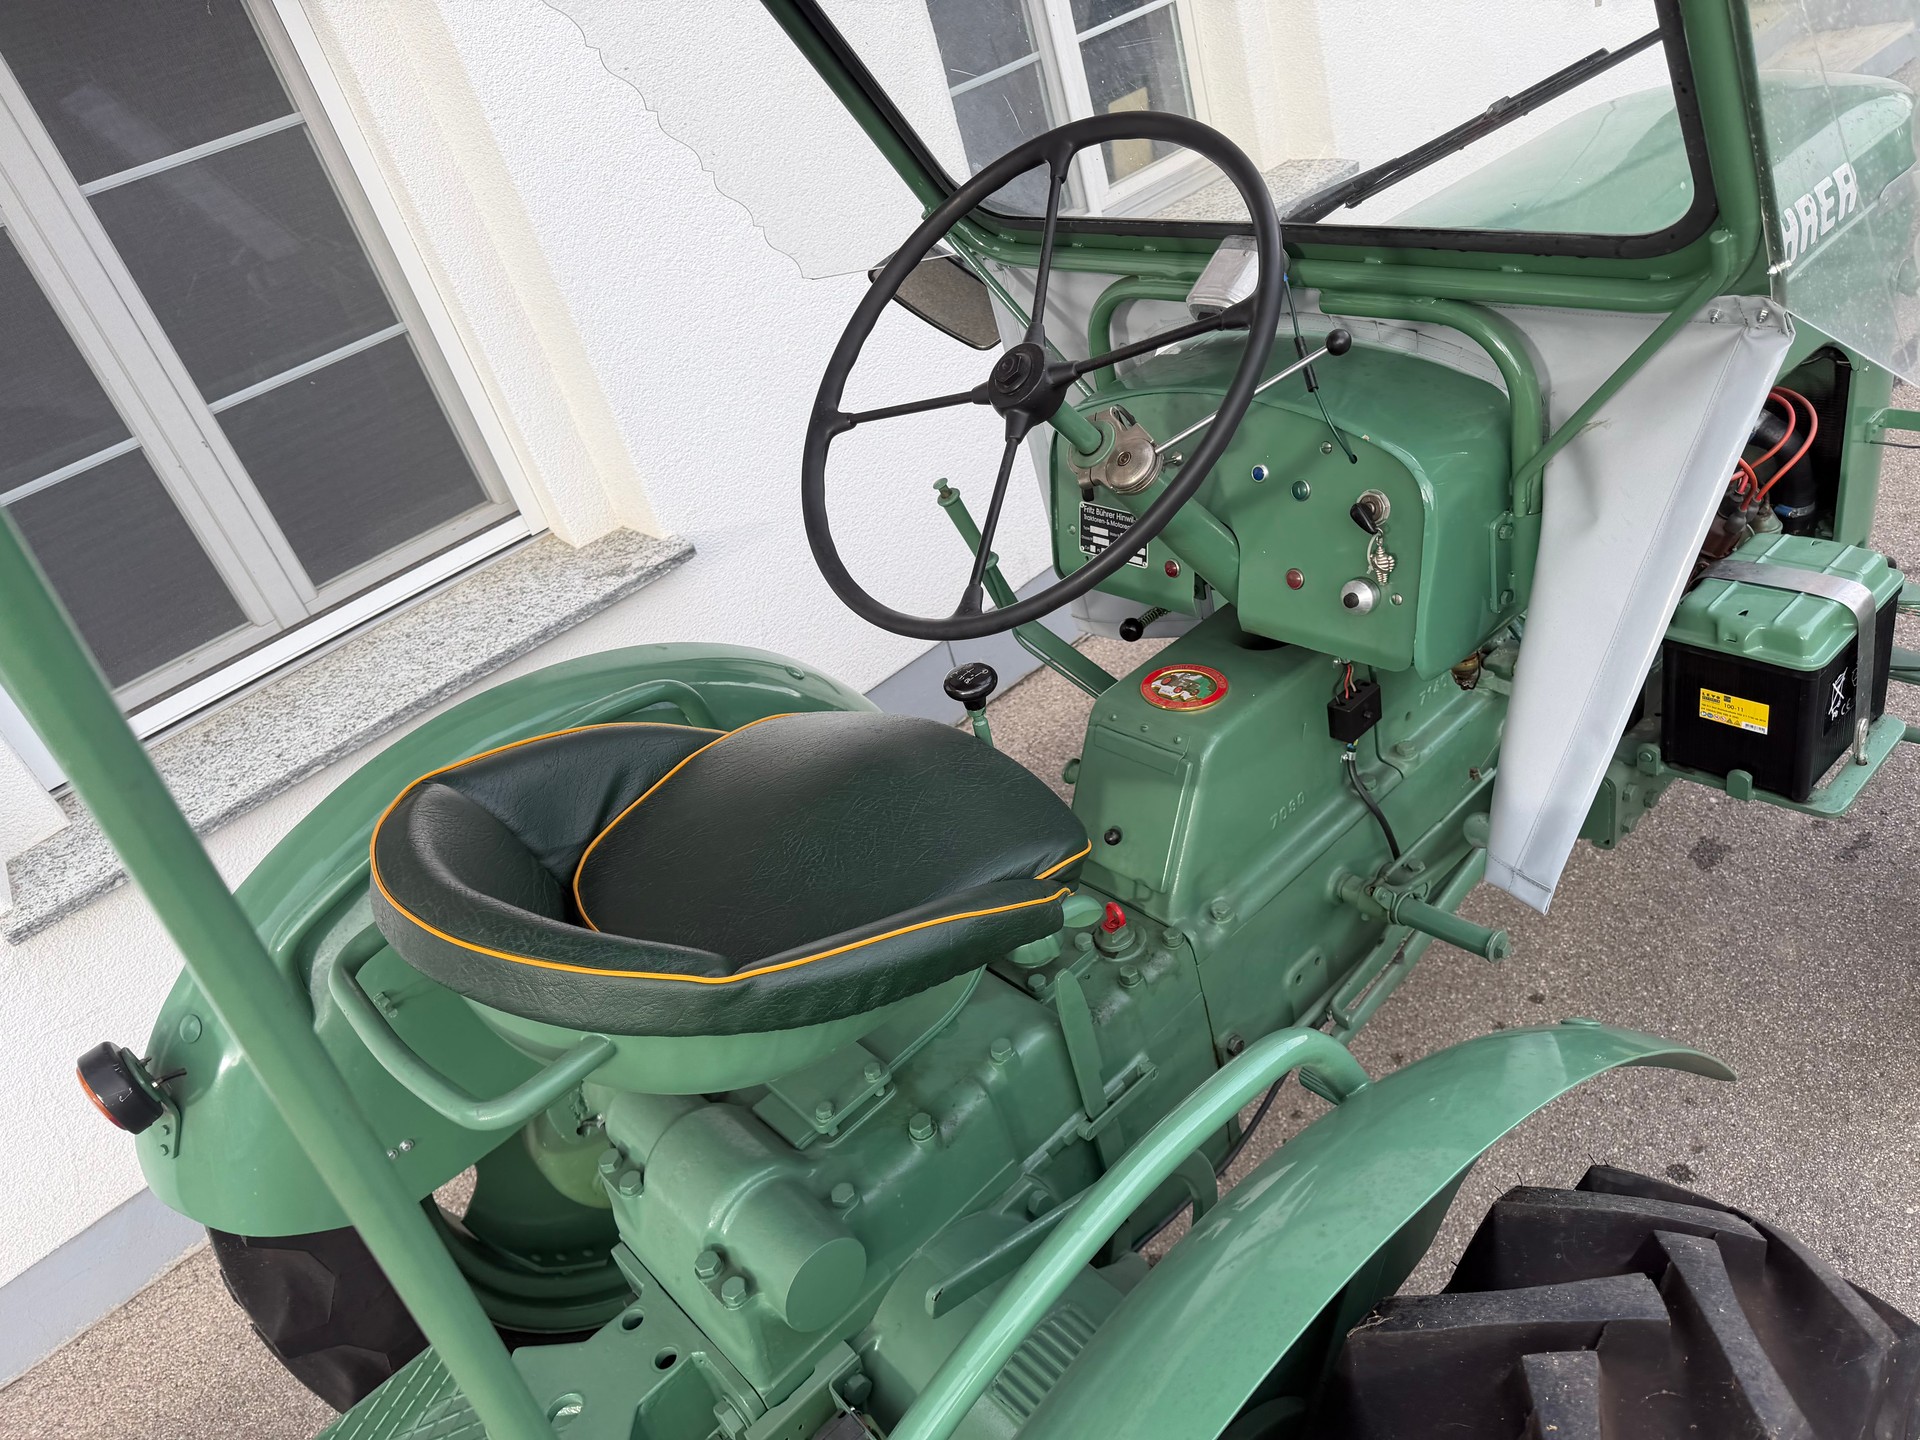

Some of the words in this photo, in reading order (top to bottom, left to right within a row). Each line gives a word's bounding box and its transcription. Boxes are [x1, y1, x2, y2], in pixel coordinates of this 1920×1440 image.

[1084, 505, 1095, 515] Fritz
[1096, 508, 1115, 519] Bührer
[1724, 703, 1744, 712] 100-11
